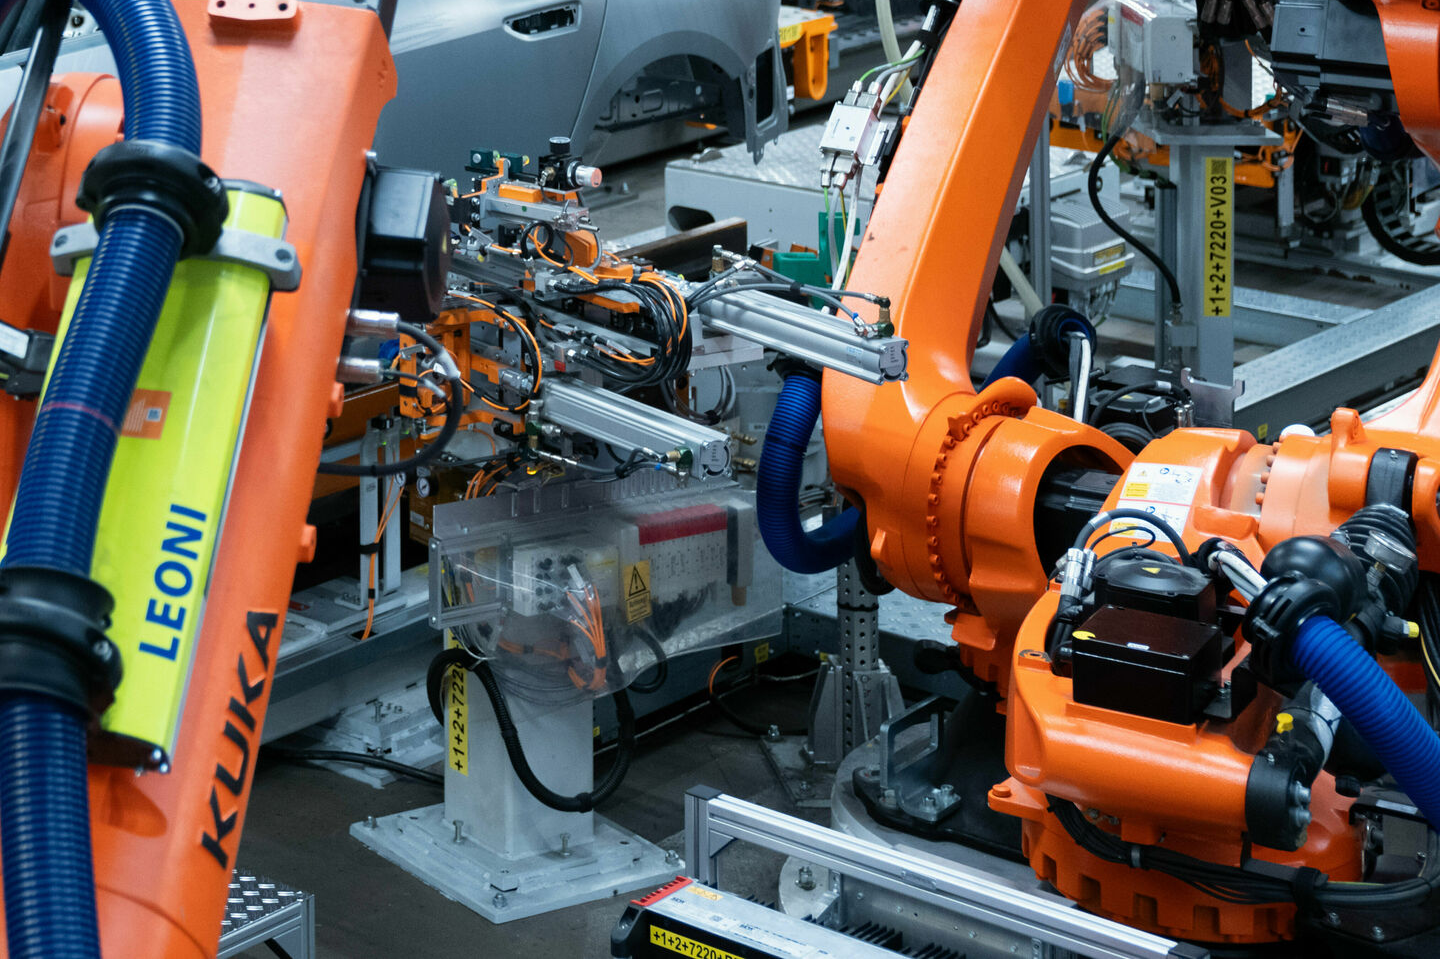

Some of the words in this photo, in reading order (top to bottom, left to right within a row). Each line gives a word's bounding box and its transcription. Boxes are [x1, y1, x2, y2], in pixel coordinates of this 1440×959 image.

[1210, 175, 1227, 316] +1+2+7220+V03
[139, 504, 208, 662] LEONI
[201, 608, 279, 871] KUKA
